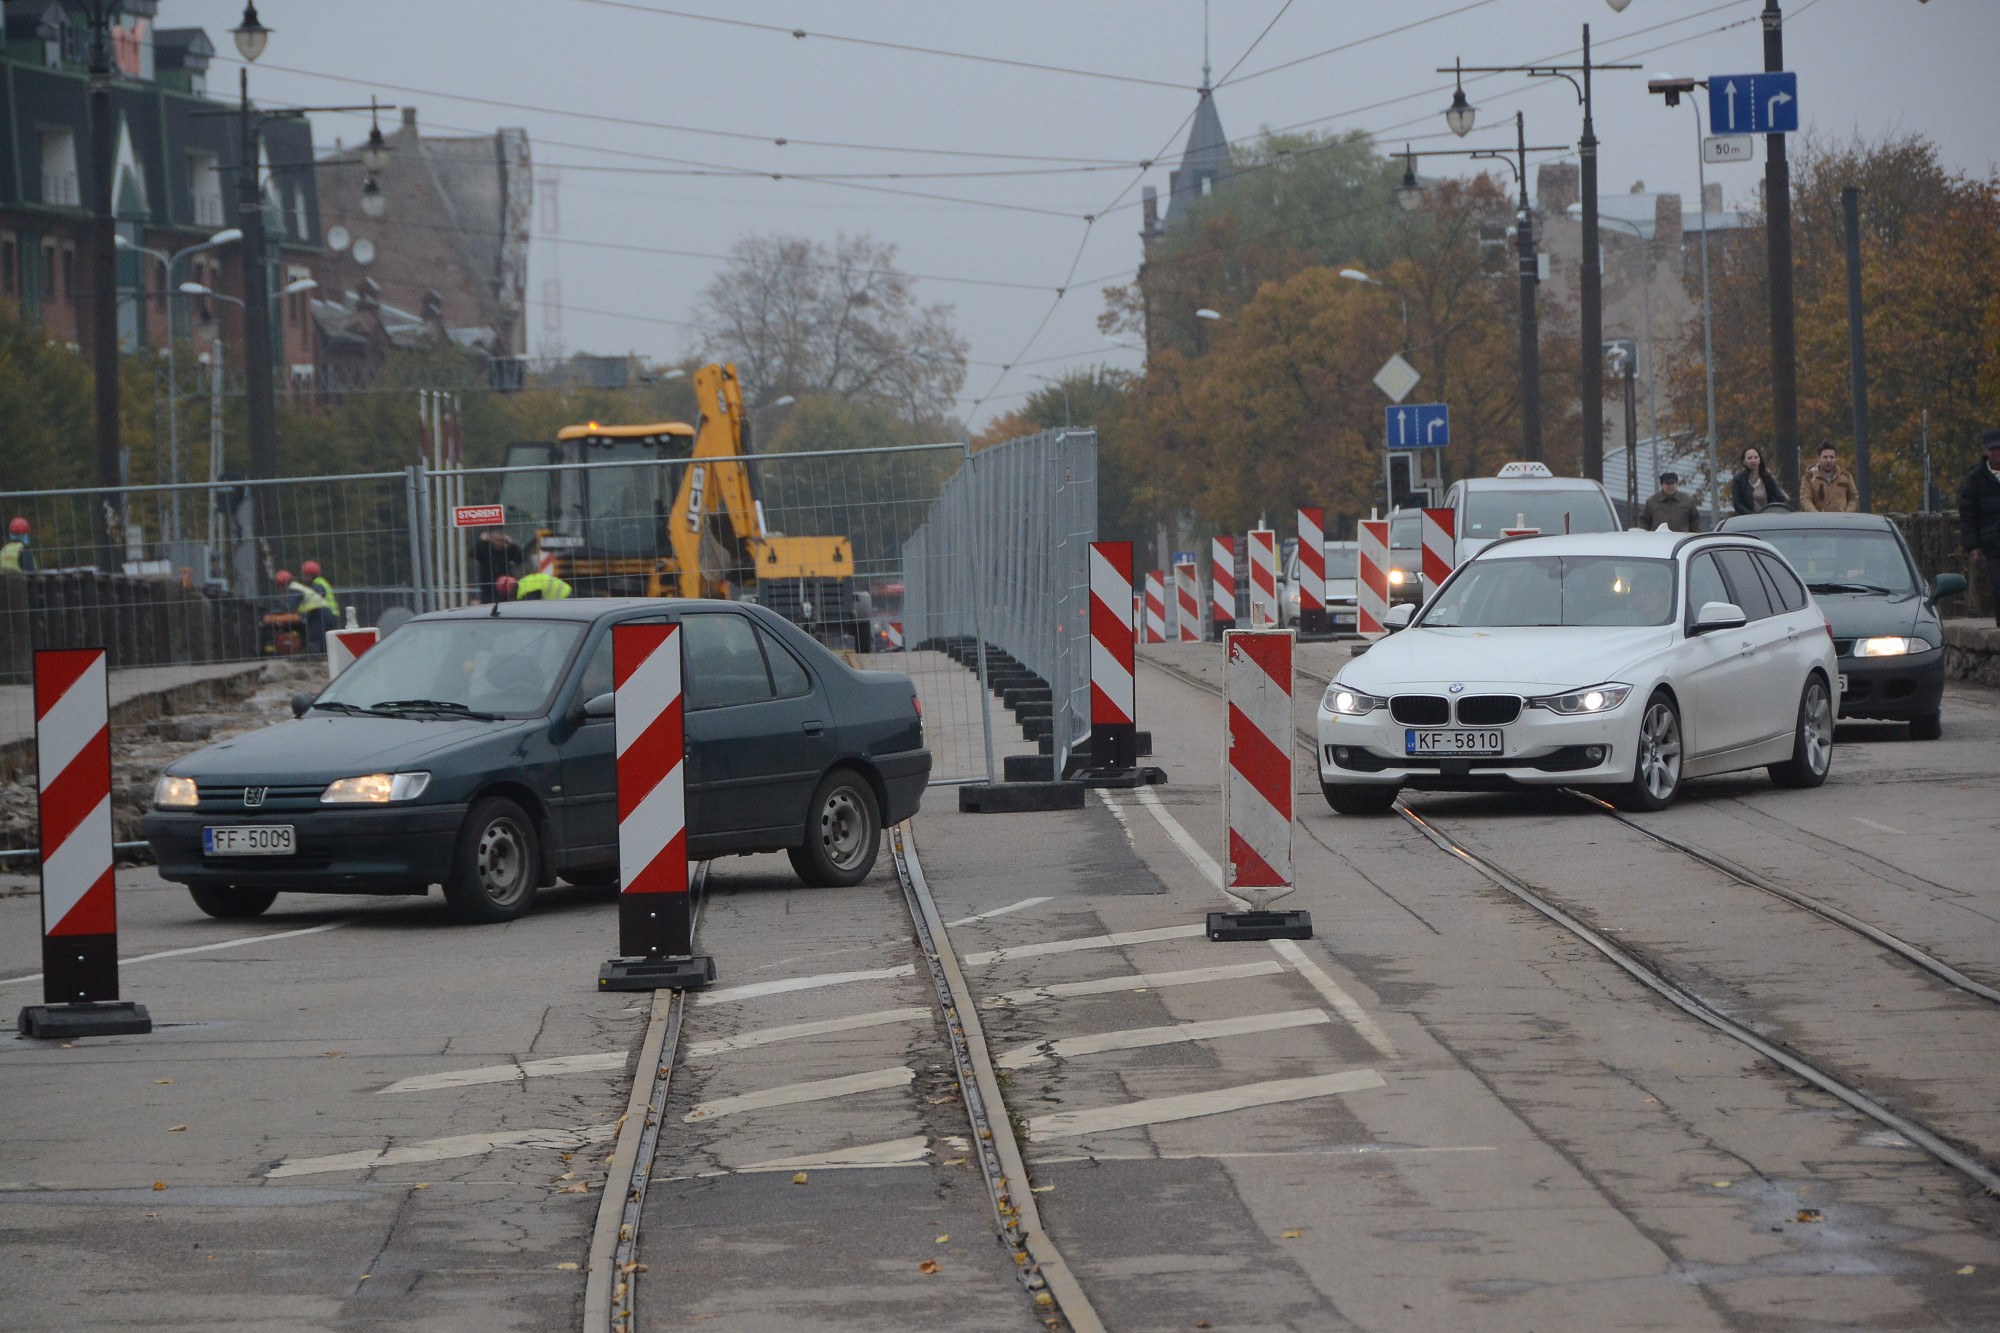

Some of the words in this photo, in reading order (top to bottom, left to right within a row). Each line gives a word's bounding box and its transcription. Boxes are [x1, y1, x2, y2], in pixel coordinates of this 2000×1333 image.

[687, 466, 705, 533] JCB
[457, 508, 501, 519] STORENT
[1419, 732, 1499, 749] KF-5810
[215, 829, 290, 849] FF-5009
